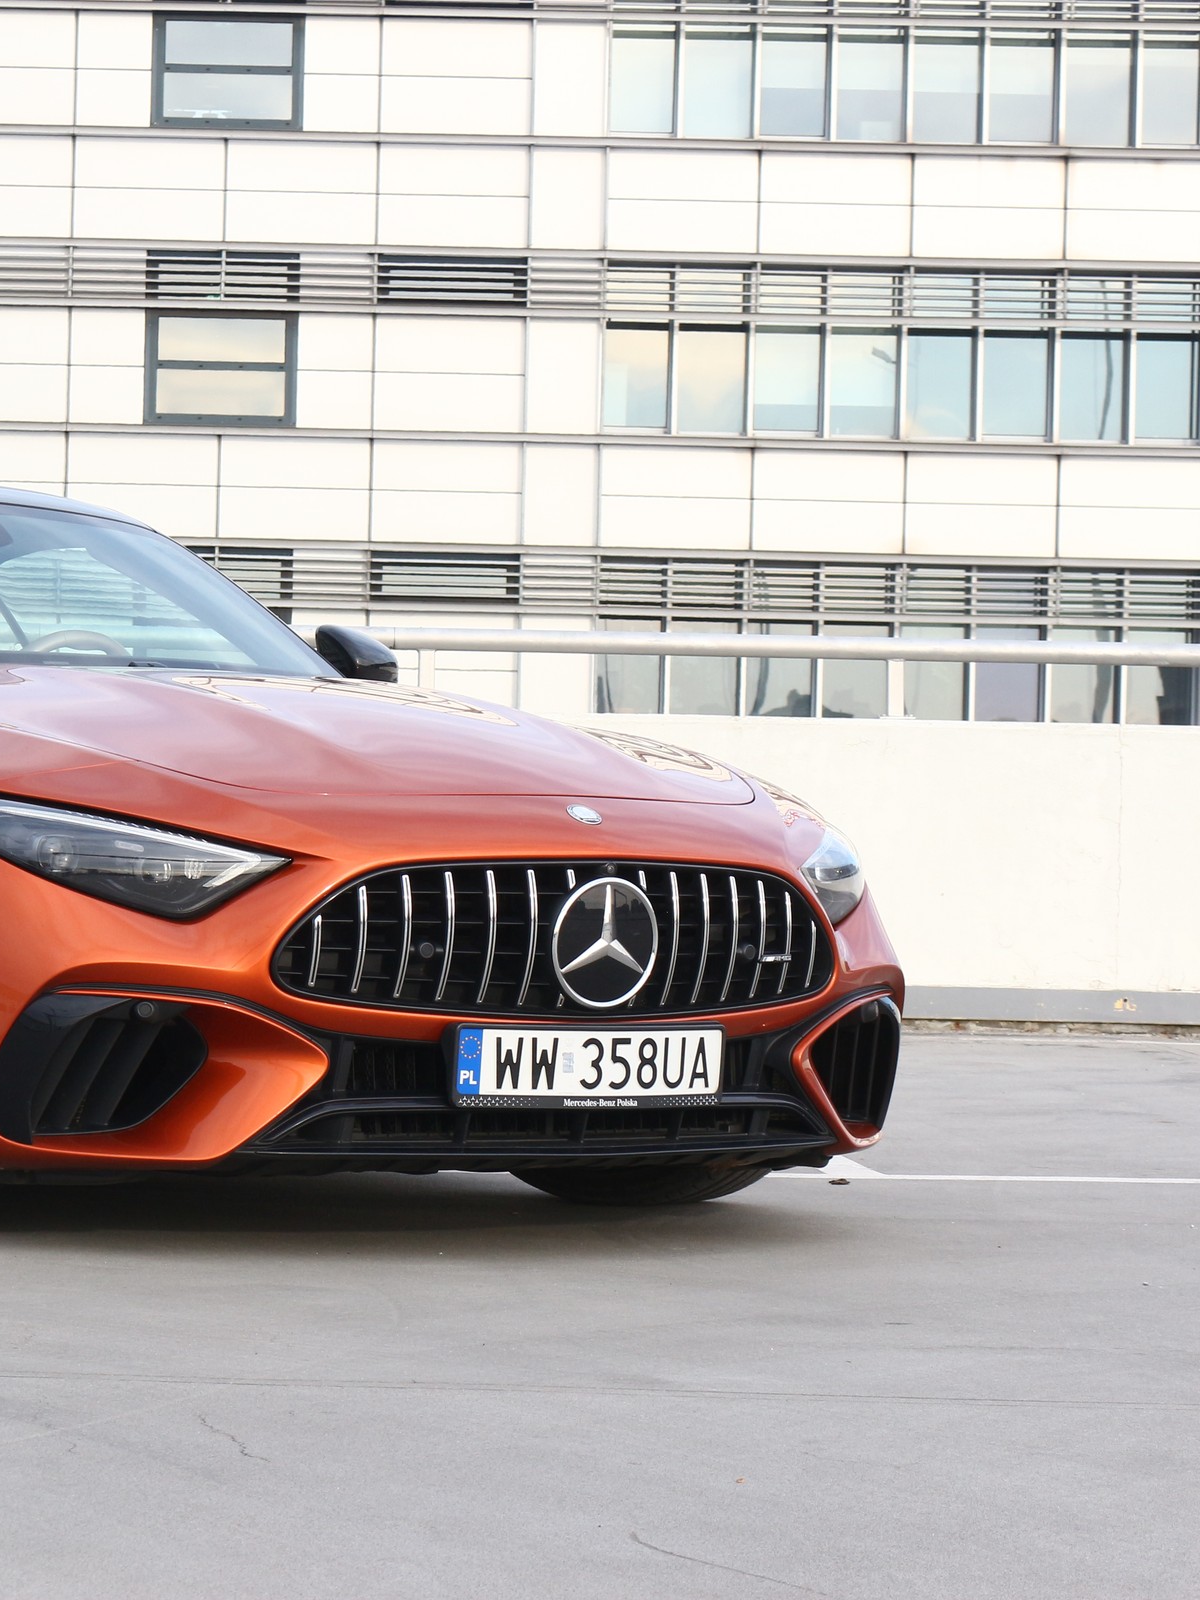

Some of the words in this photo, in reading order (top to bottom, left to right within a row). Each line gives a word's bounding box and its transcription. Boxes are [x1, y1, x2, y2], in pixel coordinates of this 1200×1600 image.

[496, 1036, 559, 1090] WW
[580, 1037, 709, 1090] 358UA
[460, 1070, 477, 1085] PL
[563, 1098, 616, 1107] Mercedes-Benz
[616, 1098, 638, 1107] Polska
